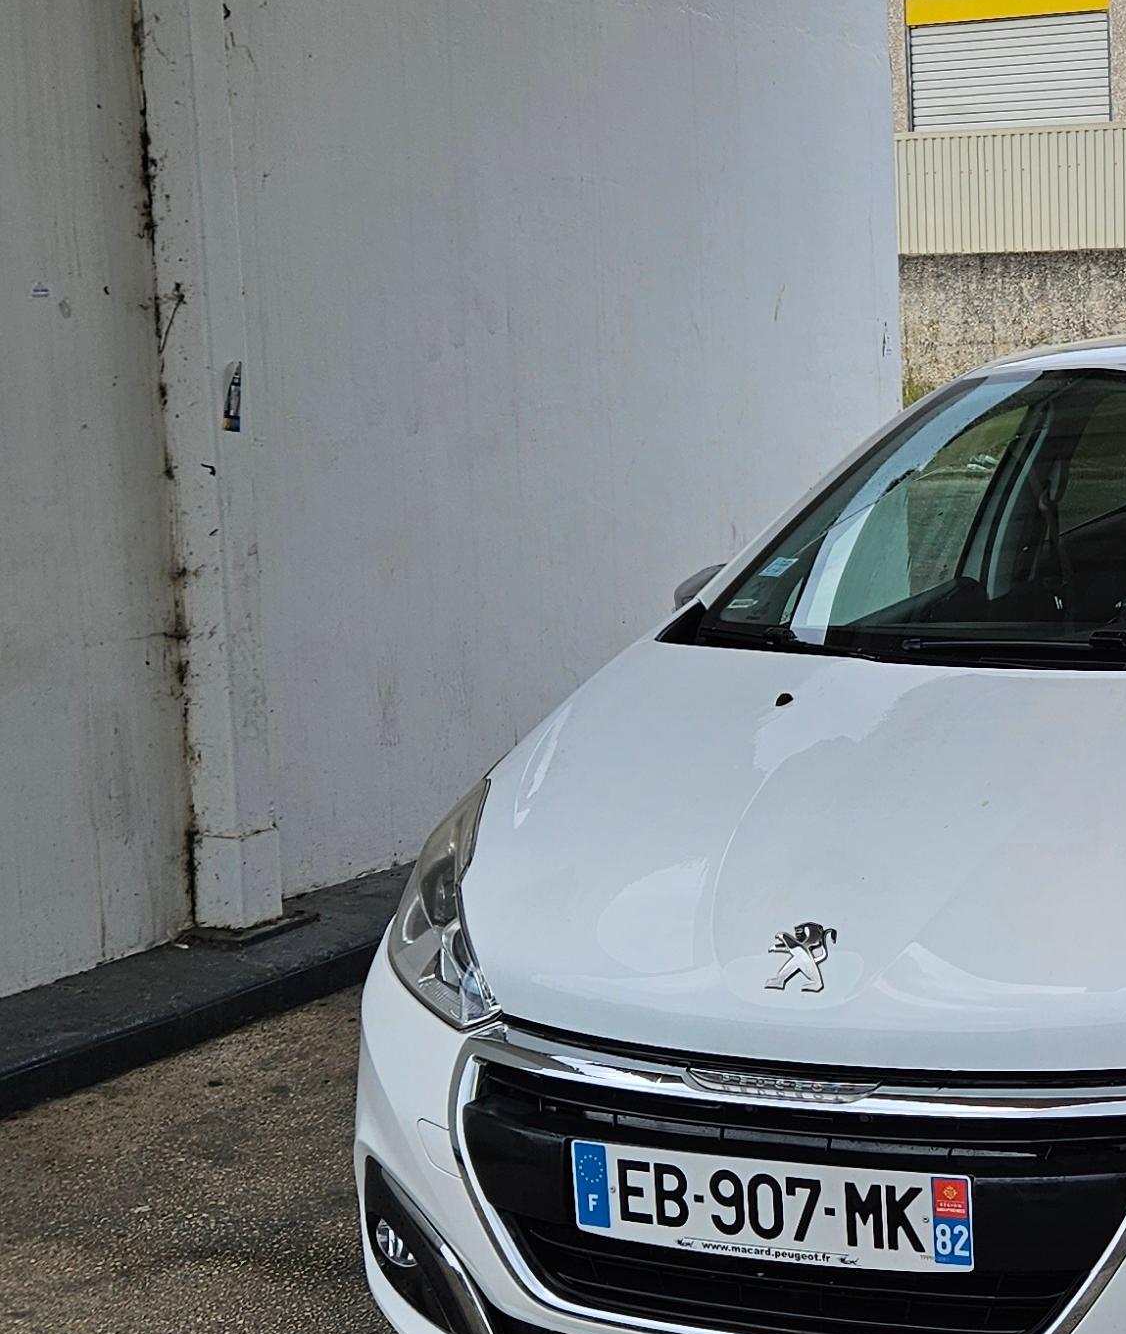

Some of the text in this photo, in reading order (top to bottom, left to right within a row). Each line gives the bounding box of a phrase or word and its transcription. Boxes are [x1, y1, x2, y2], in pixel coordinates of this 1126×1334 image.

[588, 1194, 599, 1212] F
[616, 1158, 926, 1253] EB-907-MK
[701, 1241, 831, 1263] www.macard.peugeot.fr
[935, 1223, 970, 1257] 82
